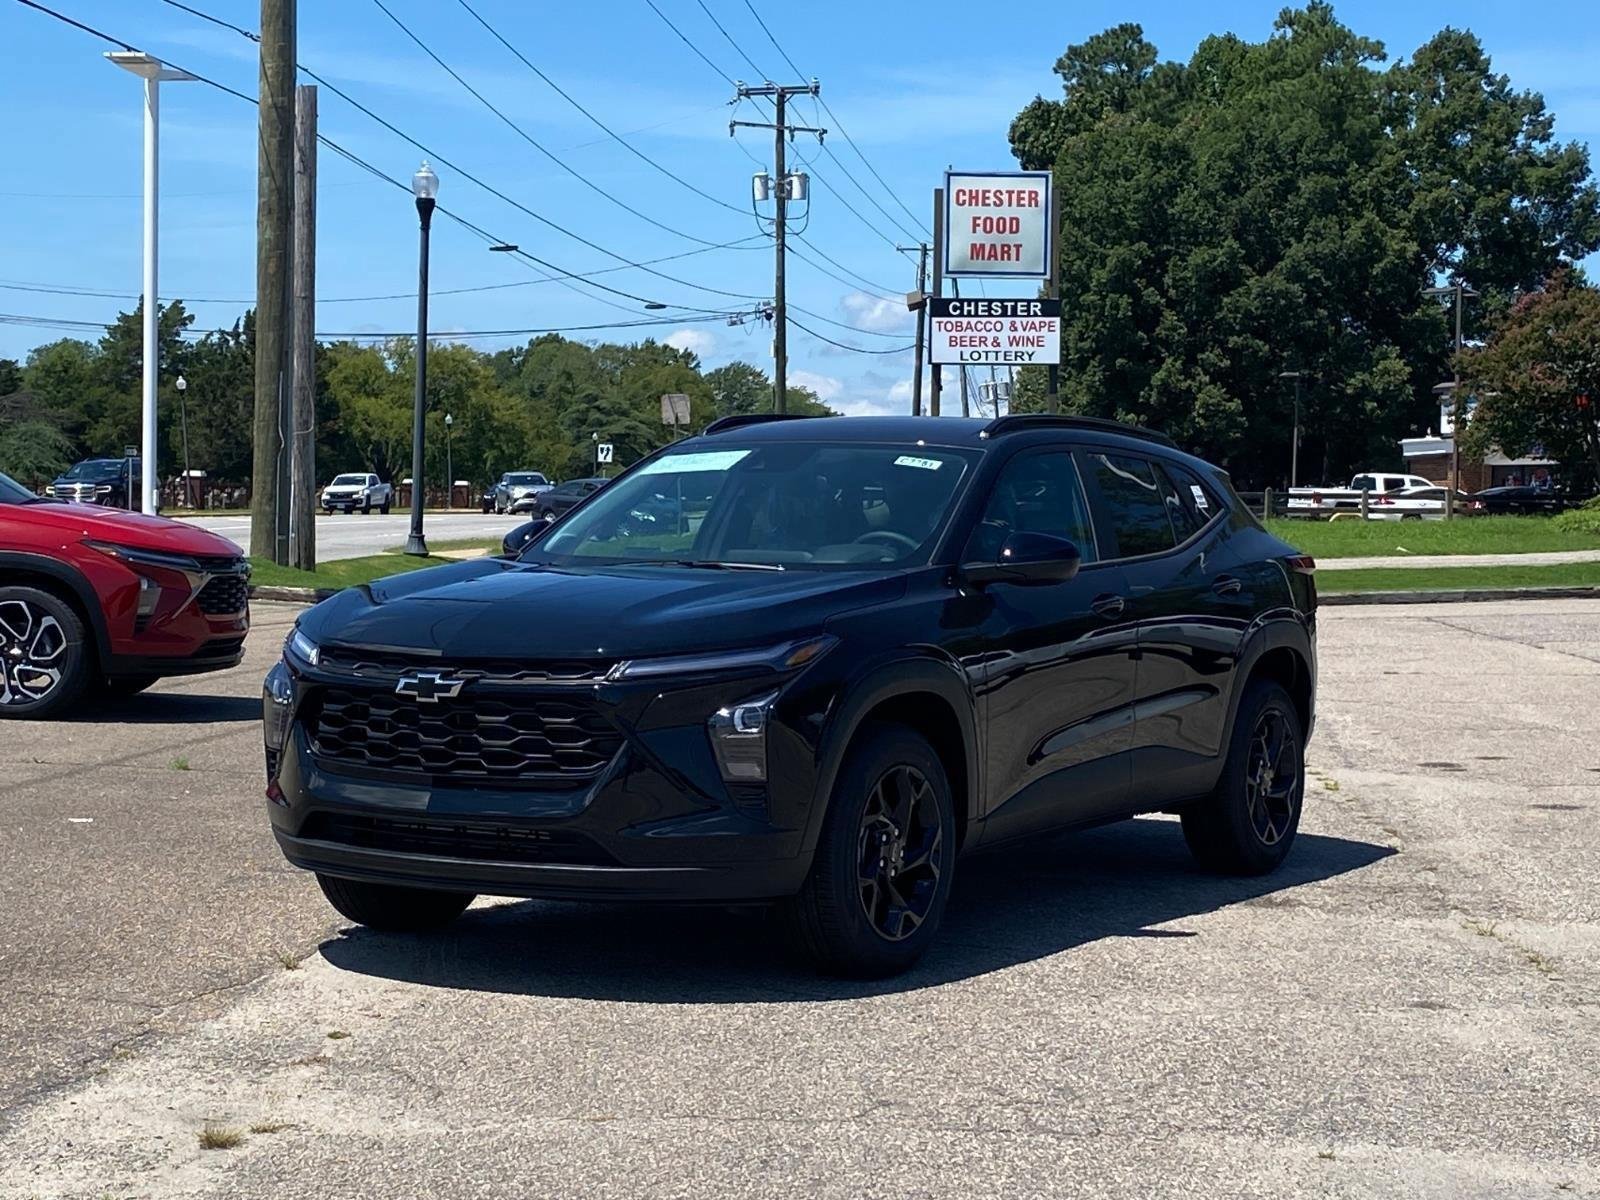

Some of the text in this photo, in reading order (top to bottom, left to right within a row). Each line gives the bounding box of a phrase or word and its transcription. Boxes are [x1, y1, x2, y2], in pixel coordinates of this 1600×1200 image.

[956, 188, 1039, 207] CHESTER
[972, 216, 1020, 234] FOOD
[970, 243, 1022, 261] MART
[949, 301, 1042, 316] CHESTER
[936, 320, 1056, 332] TOBACCO & VAPE
[949, 335, 1045, 347] BEER & WINE
[959, 351, 1036, 362] LOTTERY
